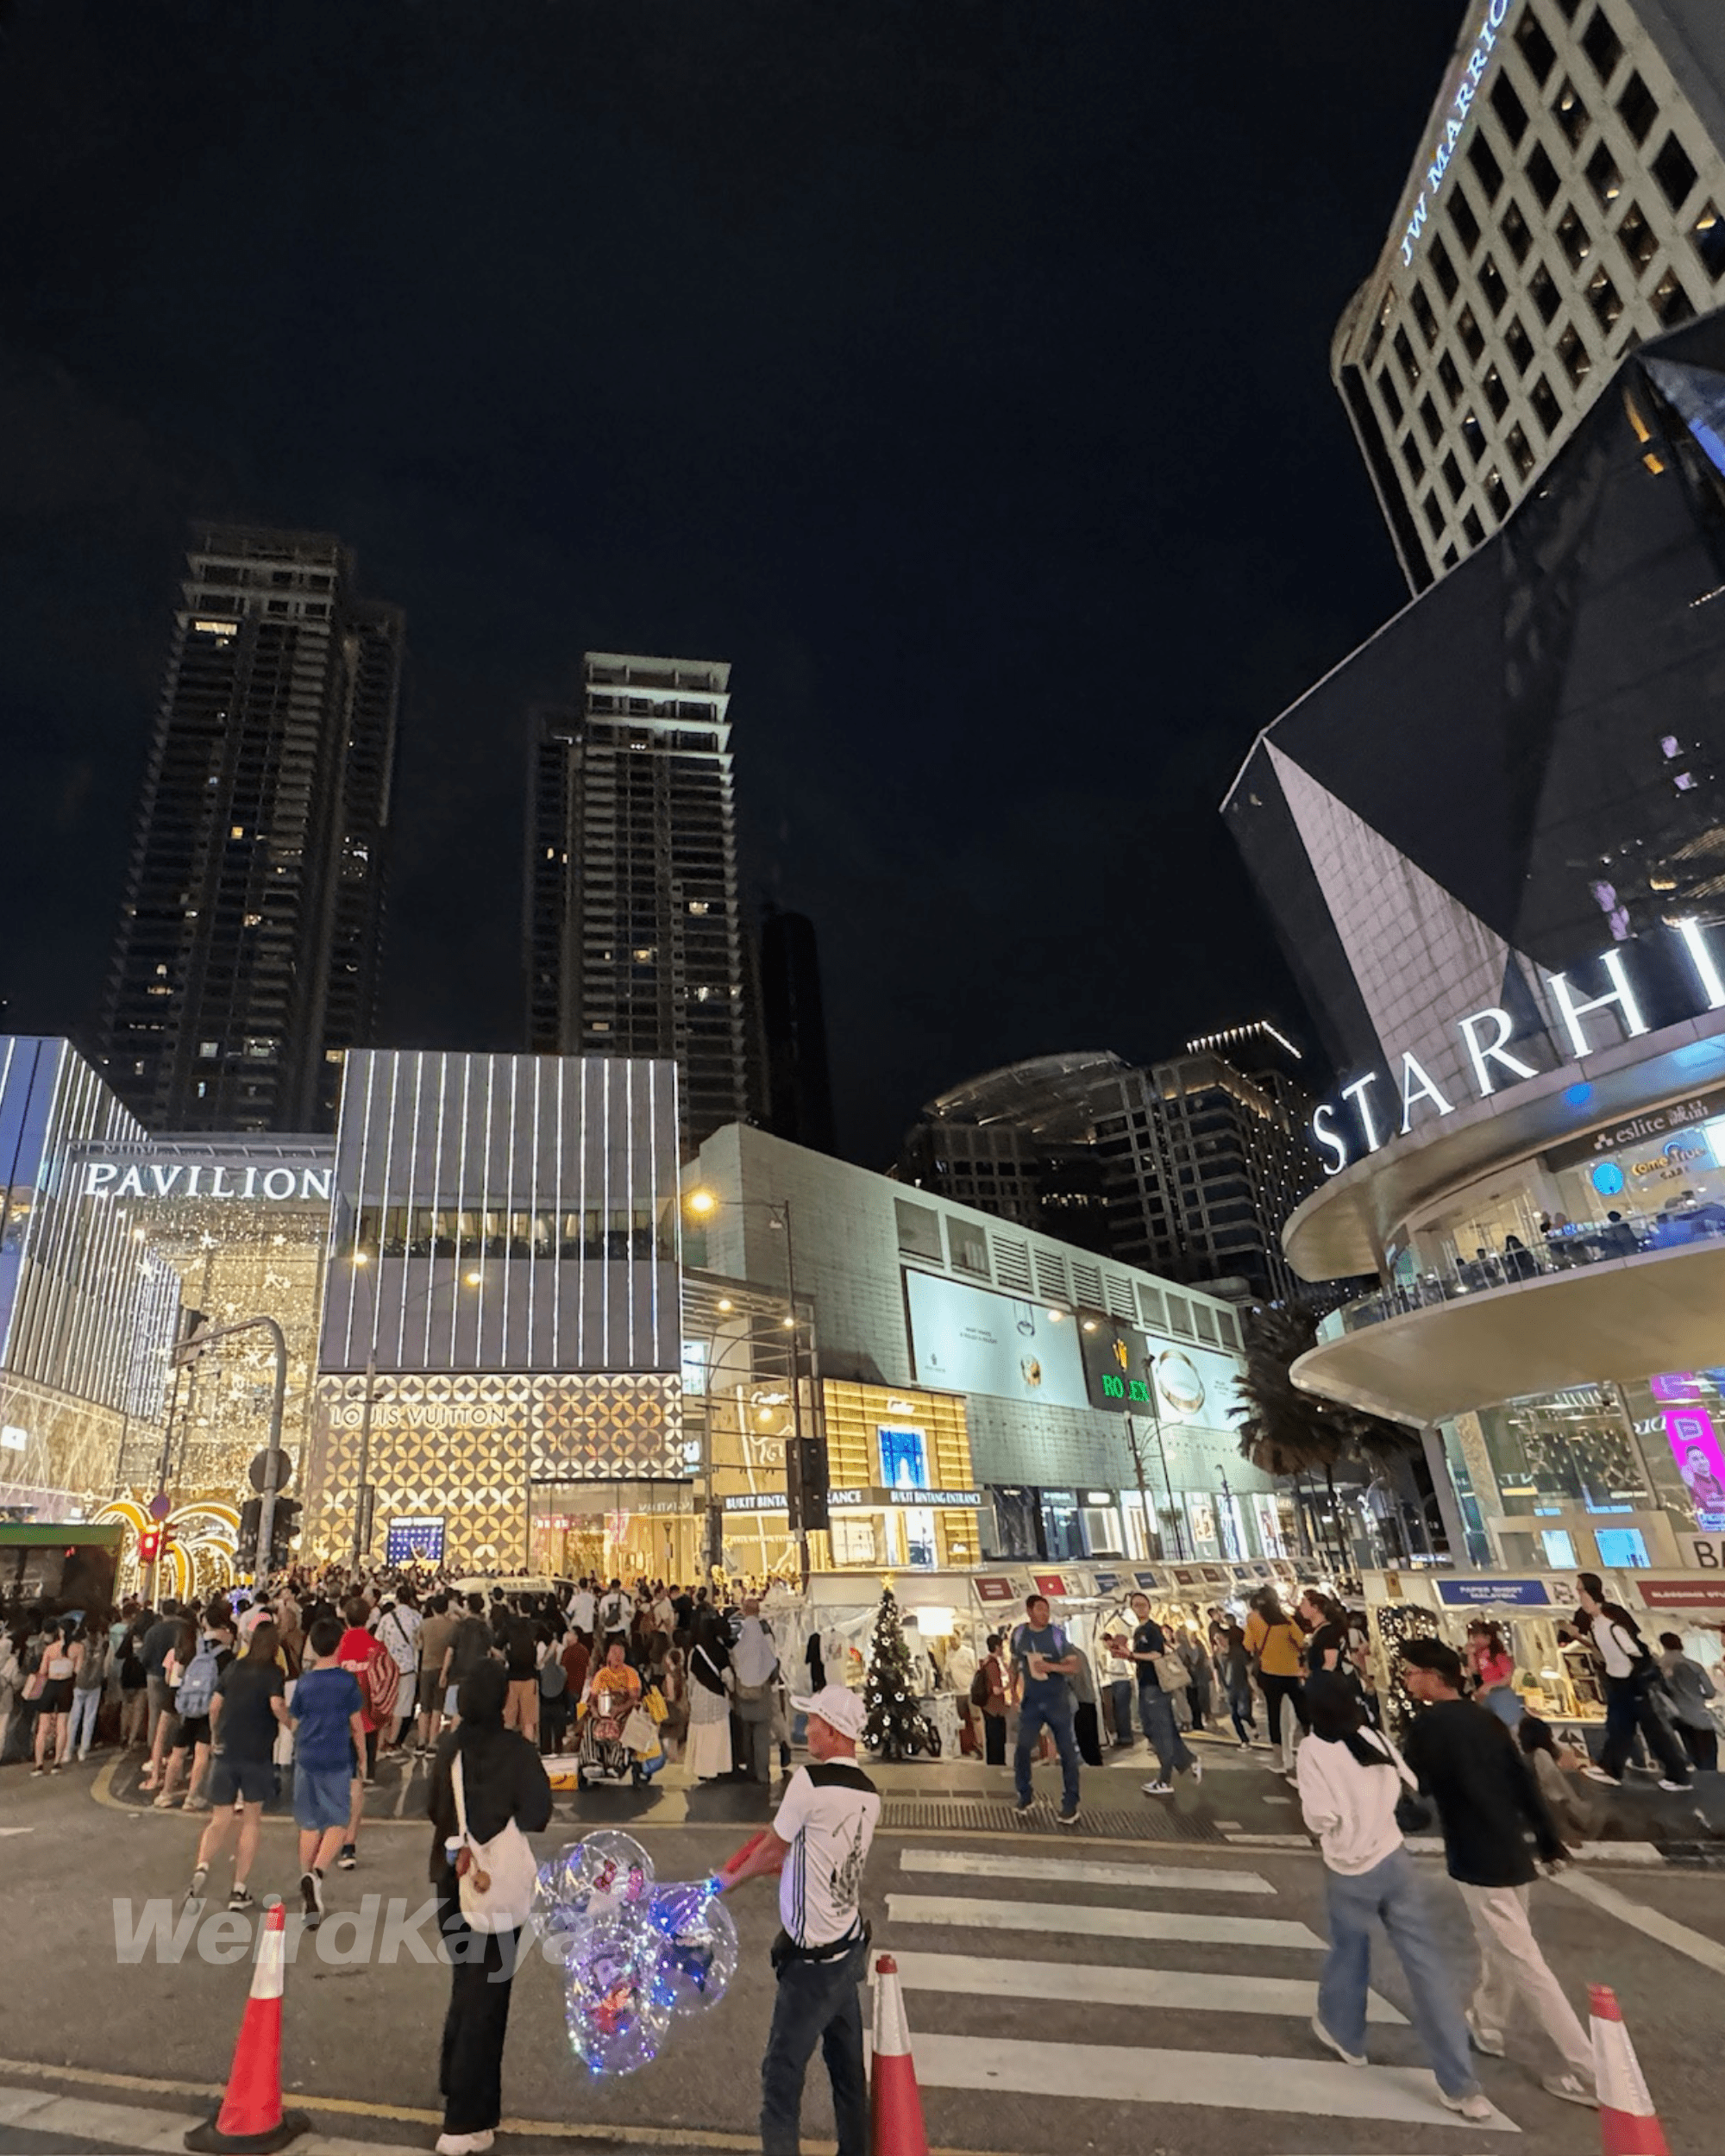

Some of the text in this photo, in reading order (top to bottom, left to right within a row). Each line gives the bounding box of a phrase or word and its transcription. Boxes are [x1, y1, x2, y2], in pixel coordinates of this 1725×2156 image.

[1401, 191, 1427, 267] JW
[1616, 1116, 1665, 1143] eslite
[85, 1163, 333, 1200] PAVILION
[1102, 1374, 1151, 1401] ROEX
[409, 1407, 506, 1426] VUITTON
[726, 1496, 756, 1509] BUKIT
[757, 1495, 788, 1507] BINTA
[891, 1490, 913, 1503] BUKIT
